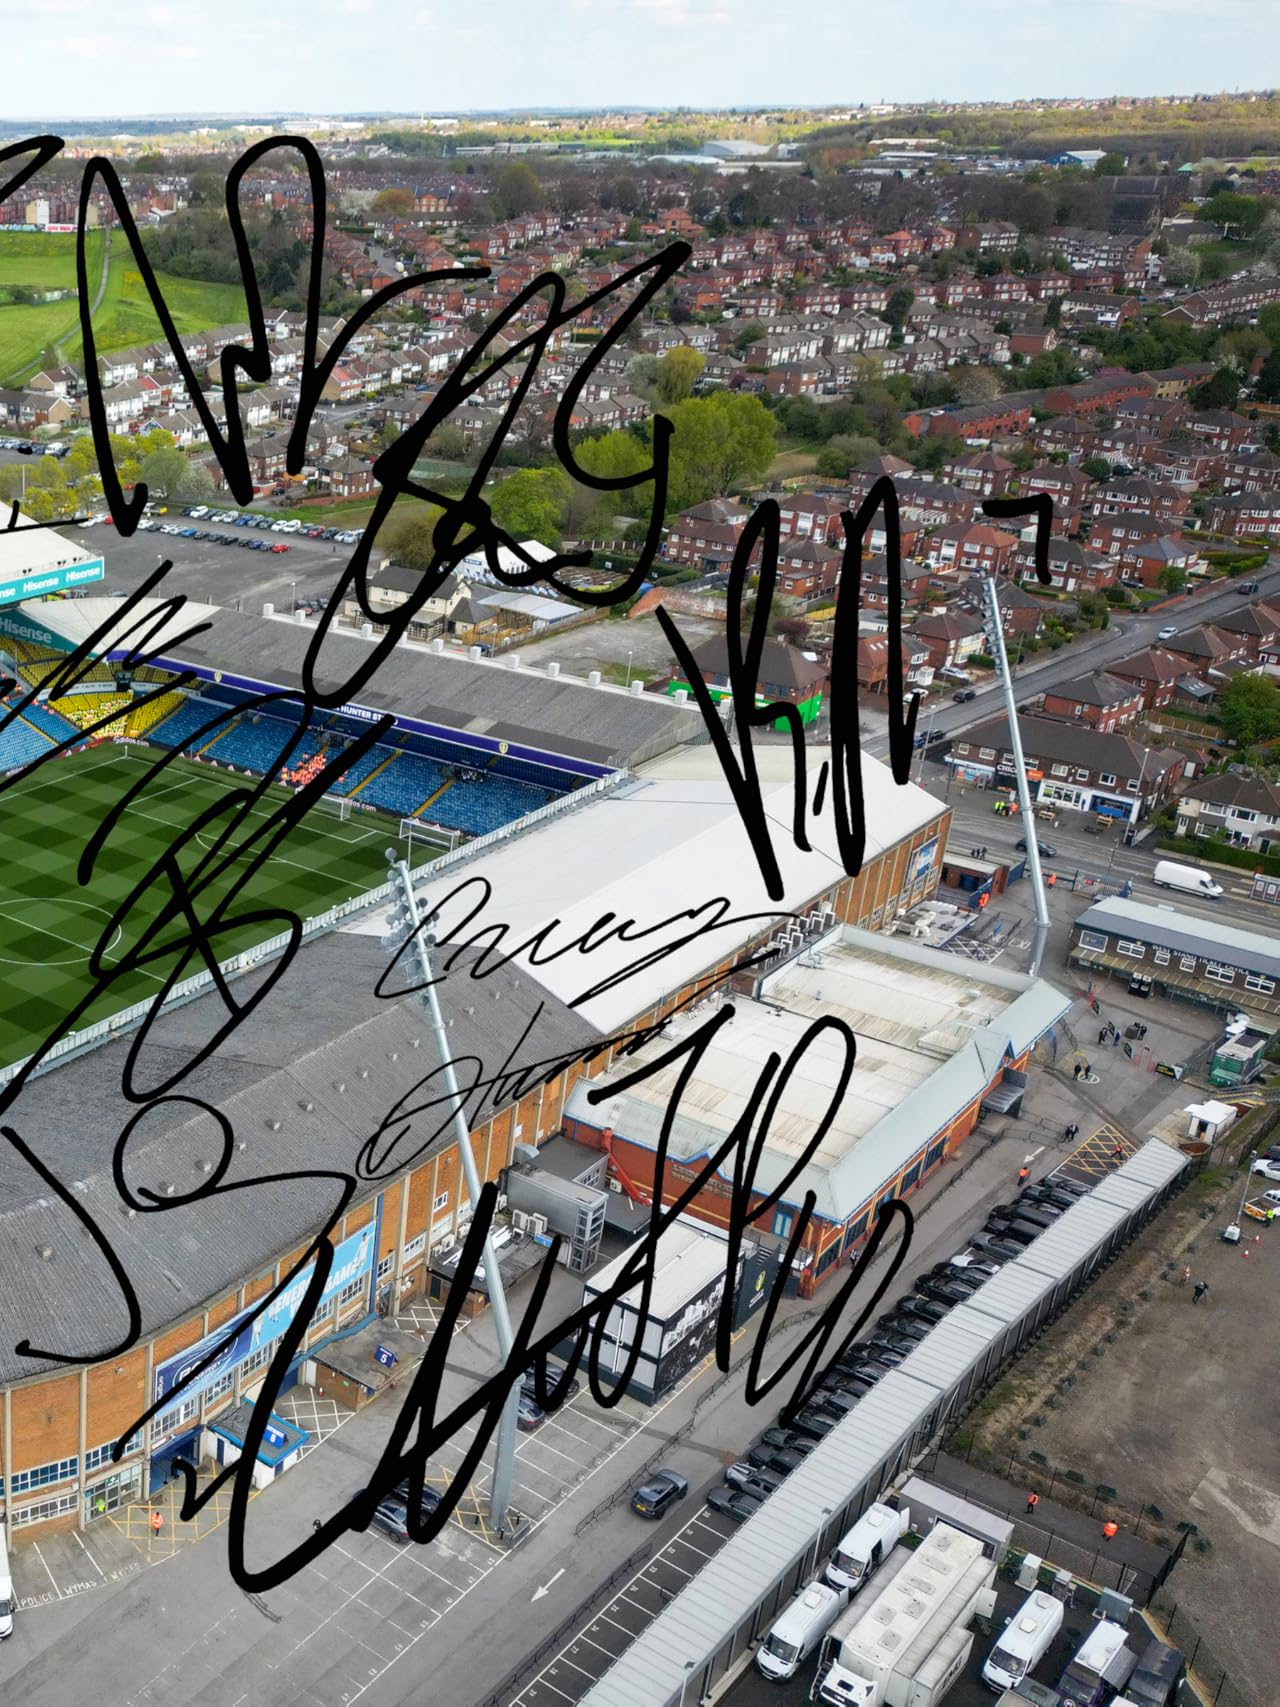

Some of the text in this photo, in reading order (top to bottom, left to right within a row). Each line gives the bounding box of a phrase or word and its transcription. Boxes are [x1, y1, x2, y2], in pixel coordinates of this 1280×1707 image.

[66, 566, 101, 582] Hisense
[23, 577, 59, 592] Hisense
[341, 705, 372, 720] HUNTER
[380, 1353, 388, 1364] 5
[64, 1580, 97, 1596] WYMAS
[21, 1592, 54, 1608] POLICE
